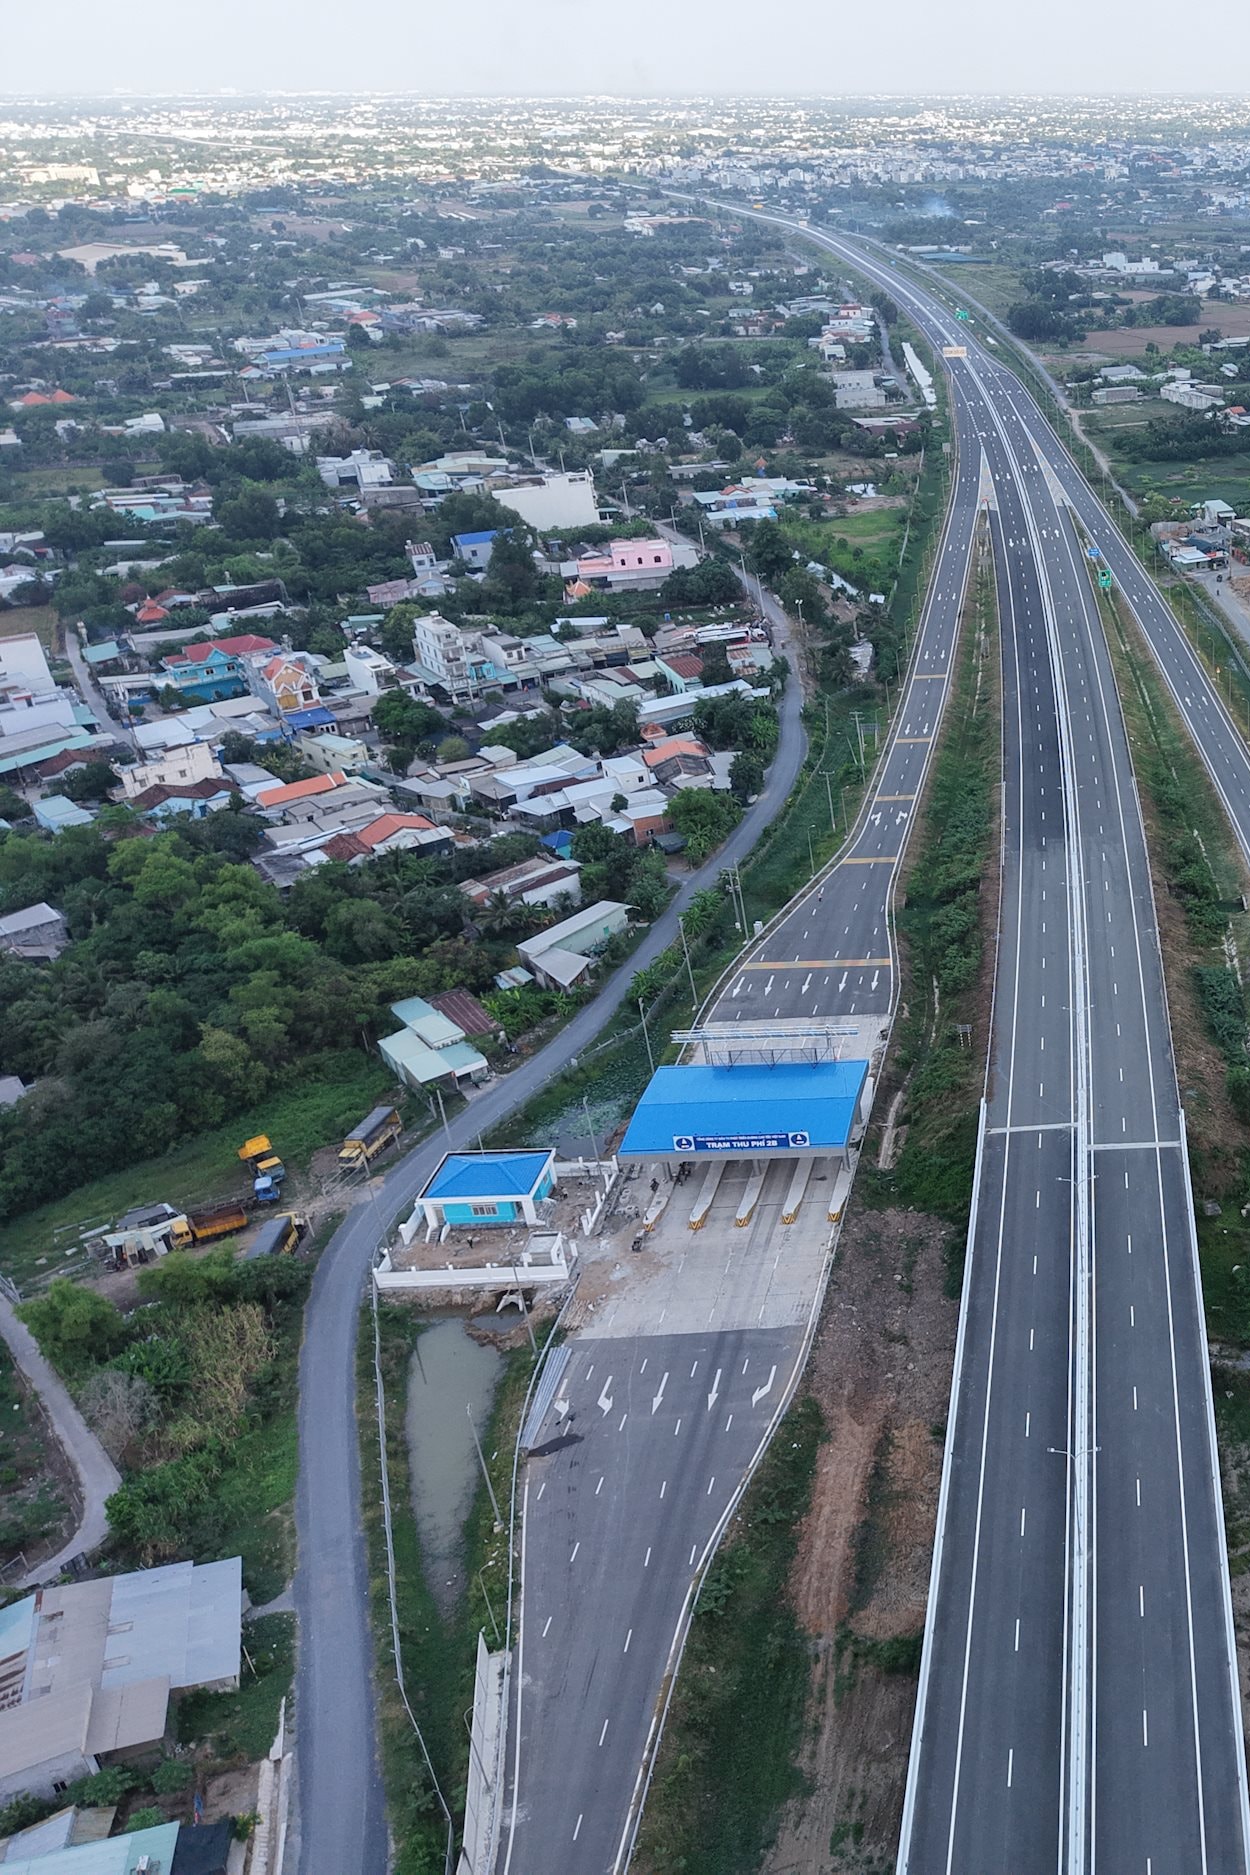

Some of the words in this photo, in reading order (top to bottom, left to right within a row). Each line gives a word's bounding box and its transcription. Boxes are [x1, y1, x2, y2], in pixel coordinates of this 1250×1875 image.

[706, 1141, 731, 1150] TRẠM
[732, 1140, 750, 1148] THU
[750, 1138, 766, 1148] PHÍ
[766, 1139, 778, 1147] 2B
